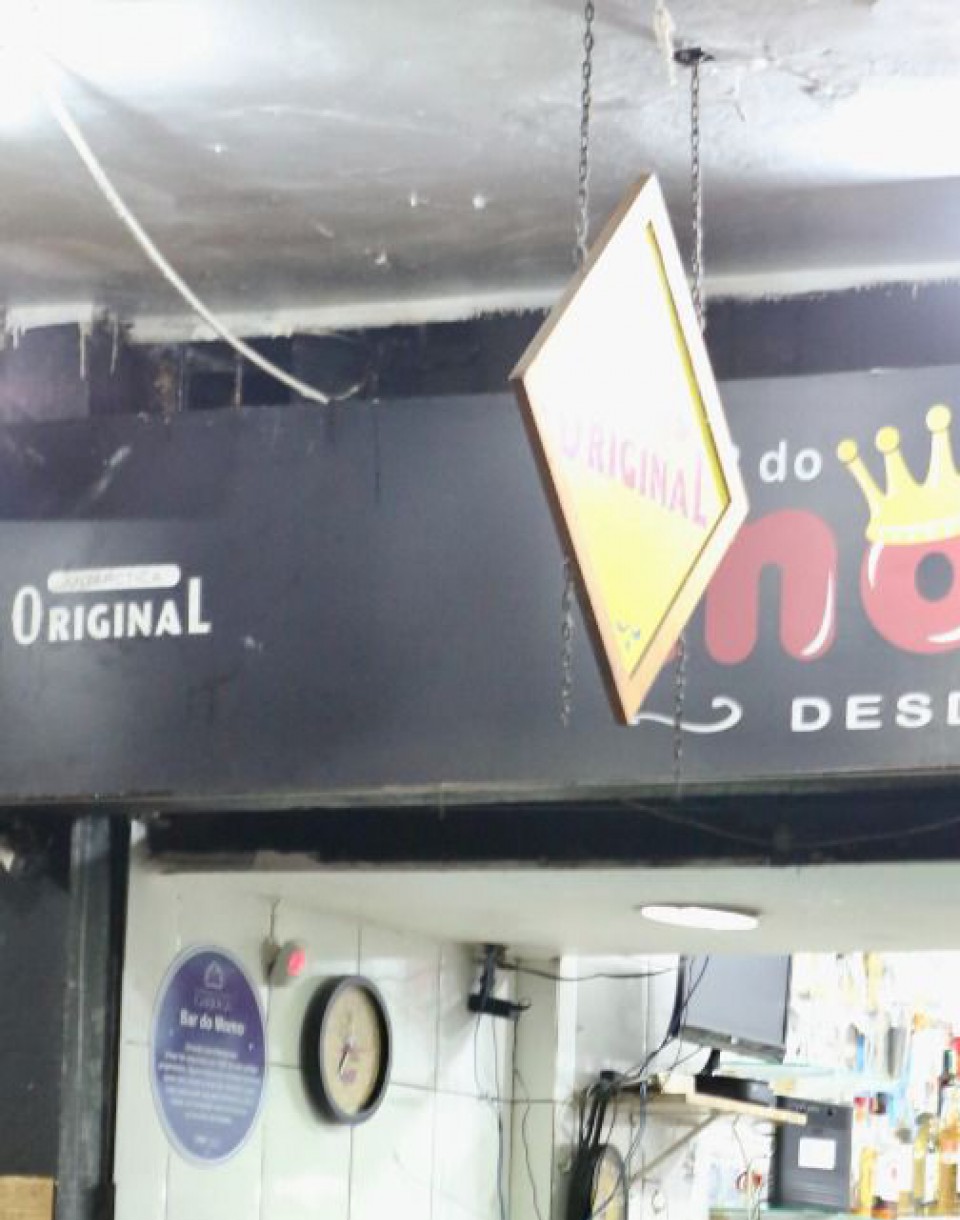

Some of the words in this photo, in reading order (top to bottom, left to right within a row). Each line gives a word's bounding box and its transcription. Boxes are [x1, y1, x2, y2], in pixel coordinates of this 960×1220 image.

[560, 413, 709, 529] ORIGINAL
[760, 438, 822, 482] do
[12, 576, 212, 645] ORIGINAL
